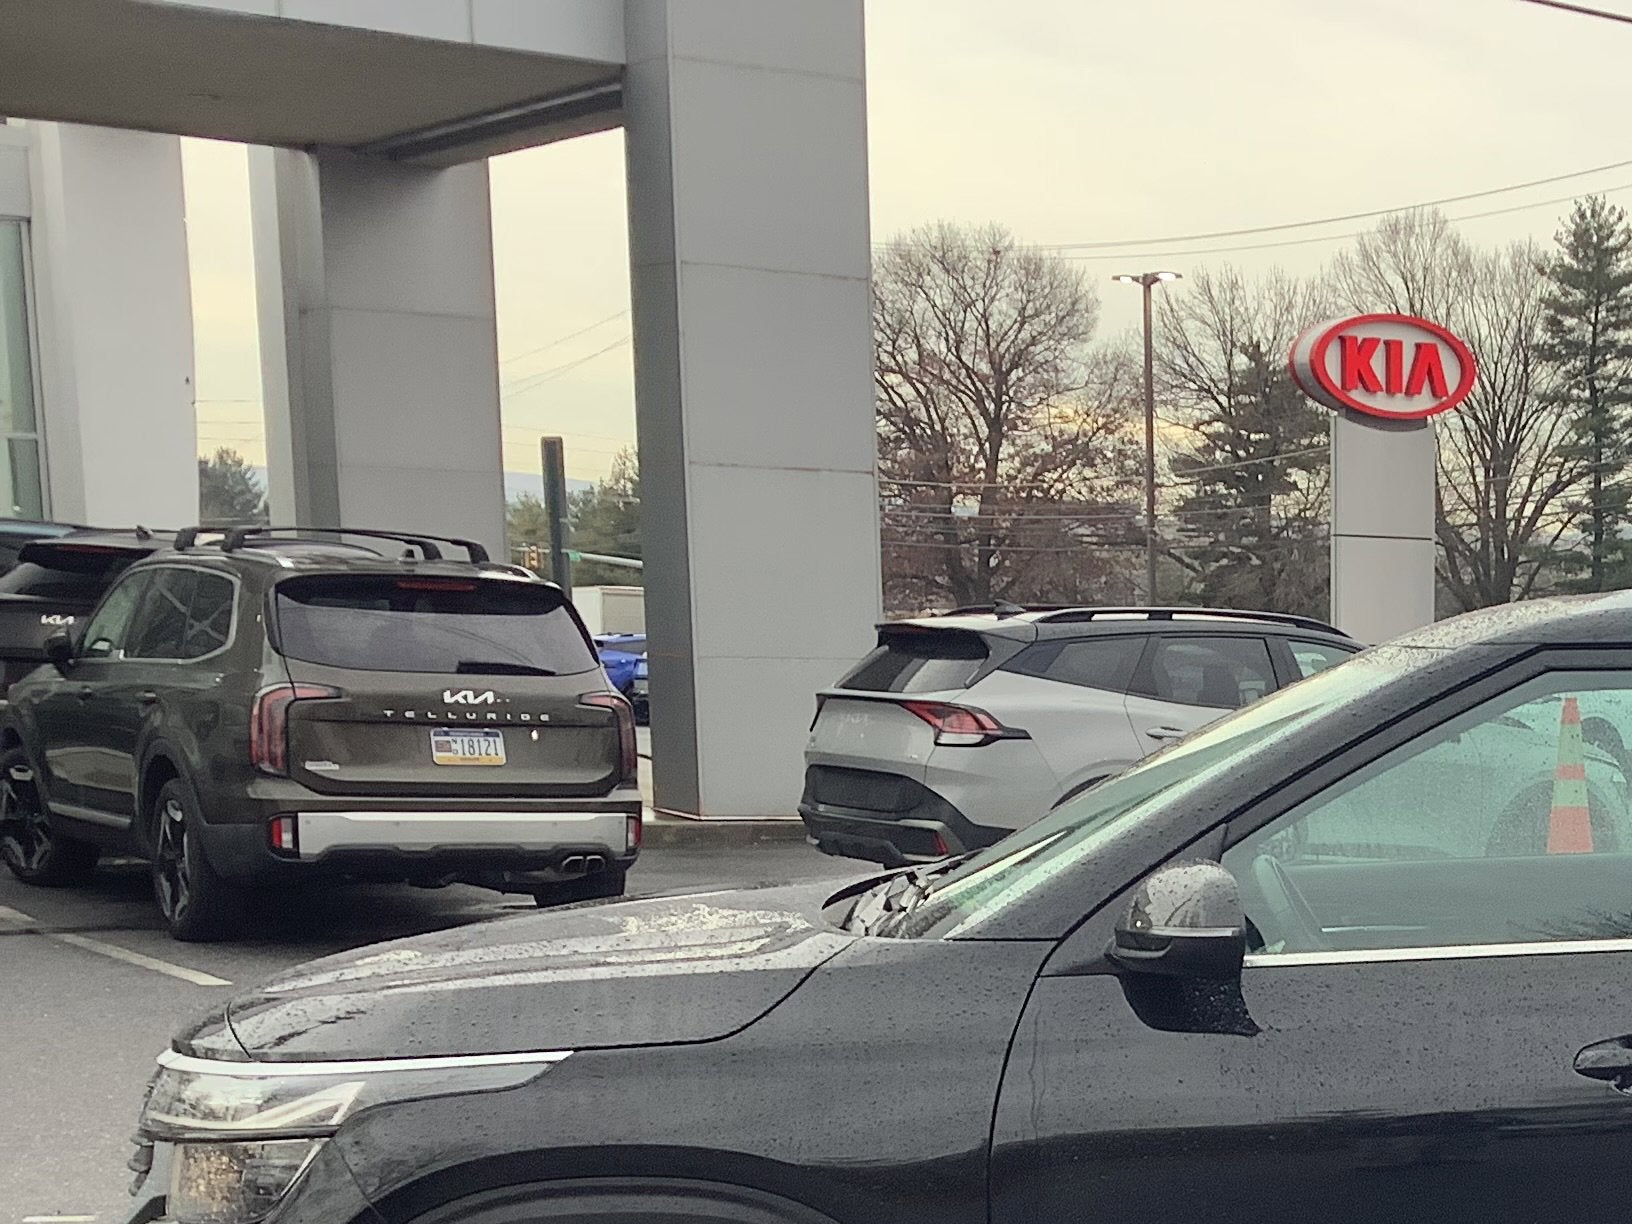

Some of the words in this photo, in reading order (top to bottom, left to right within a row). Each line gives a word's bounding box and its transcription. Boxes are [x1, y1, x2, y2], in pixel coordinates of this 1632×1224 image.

[1338, 335, 1449, 399] KIA
[443, 690, 495, 704] KIA
[383, 709, 550, 722] TELLURIDE
